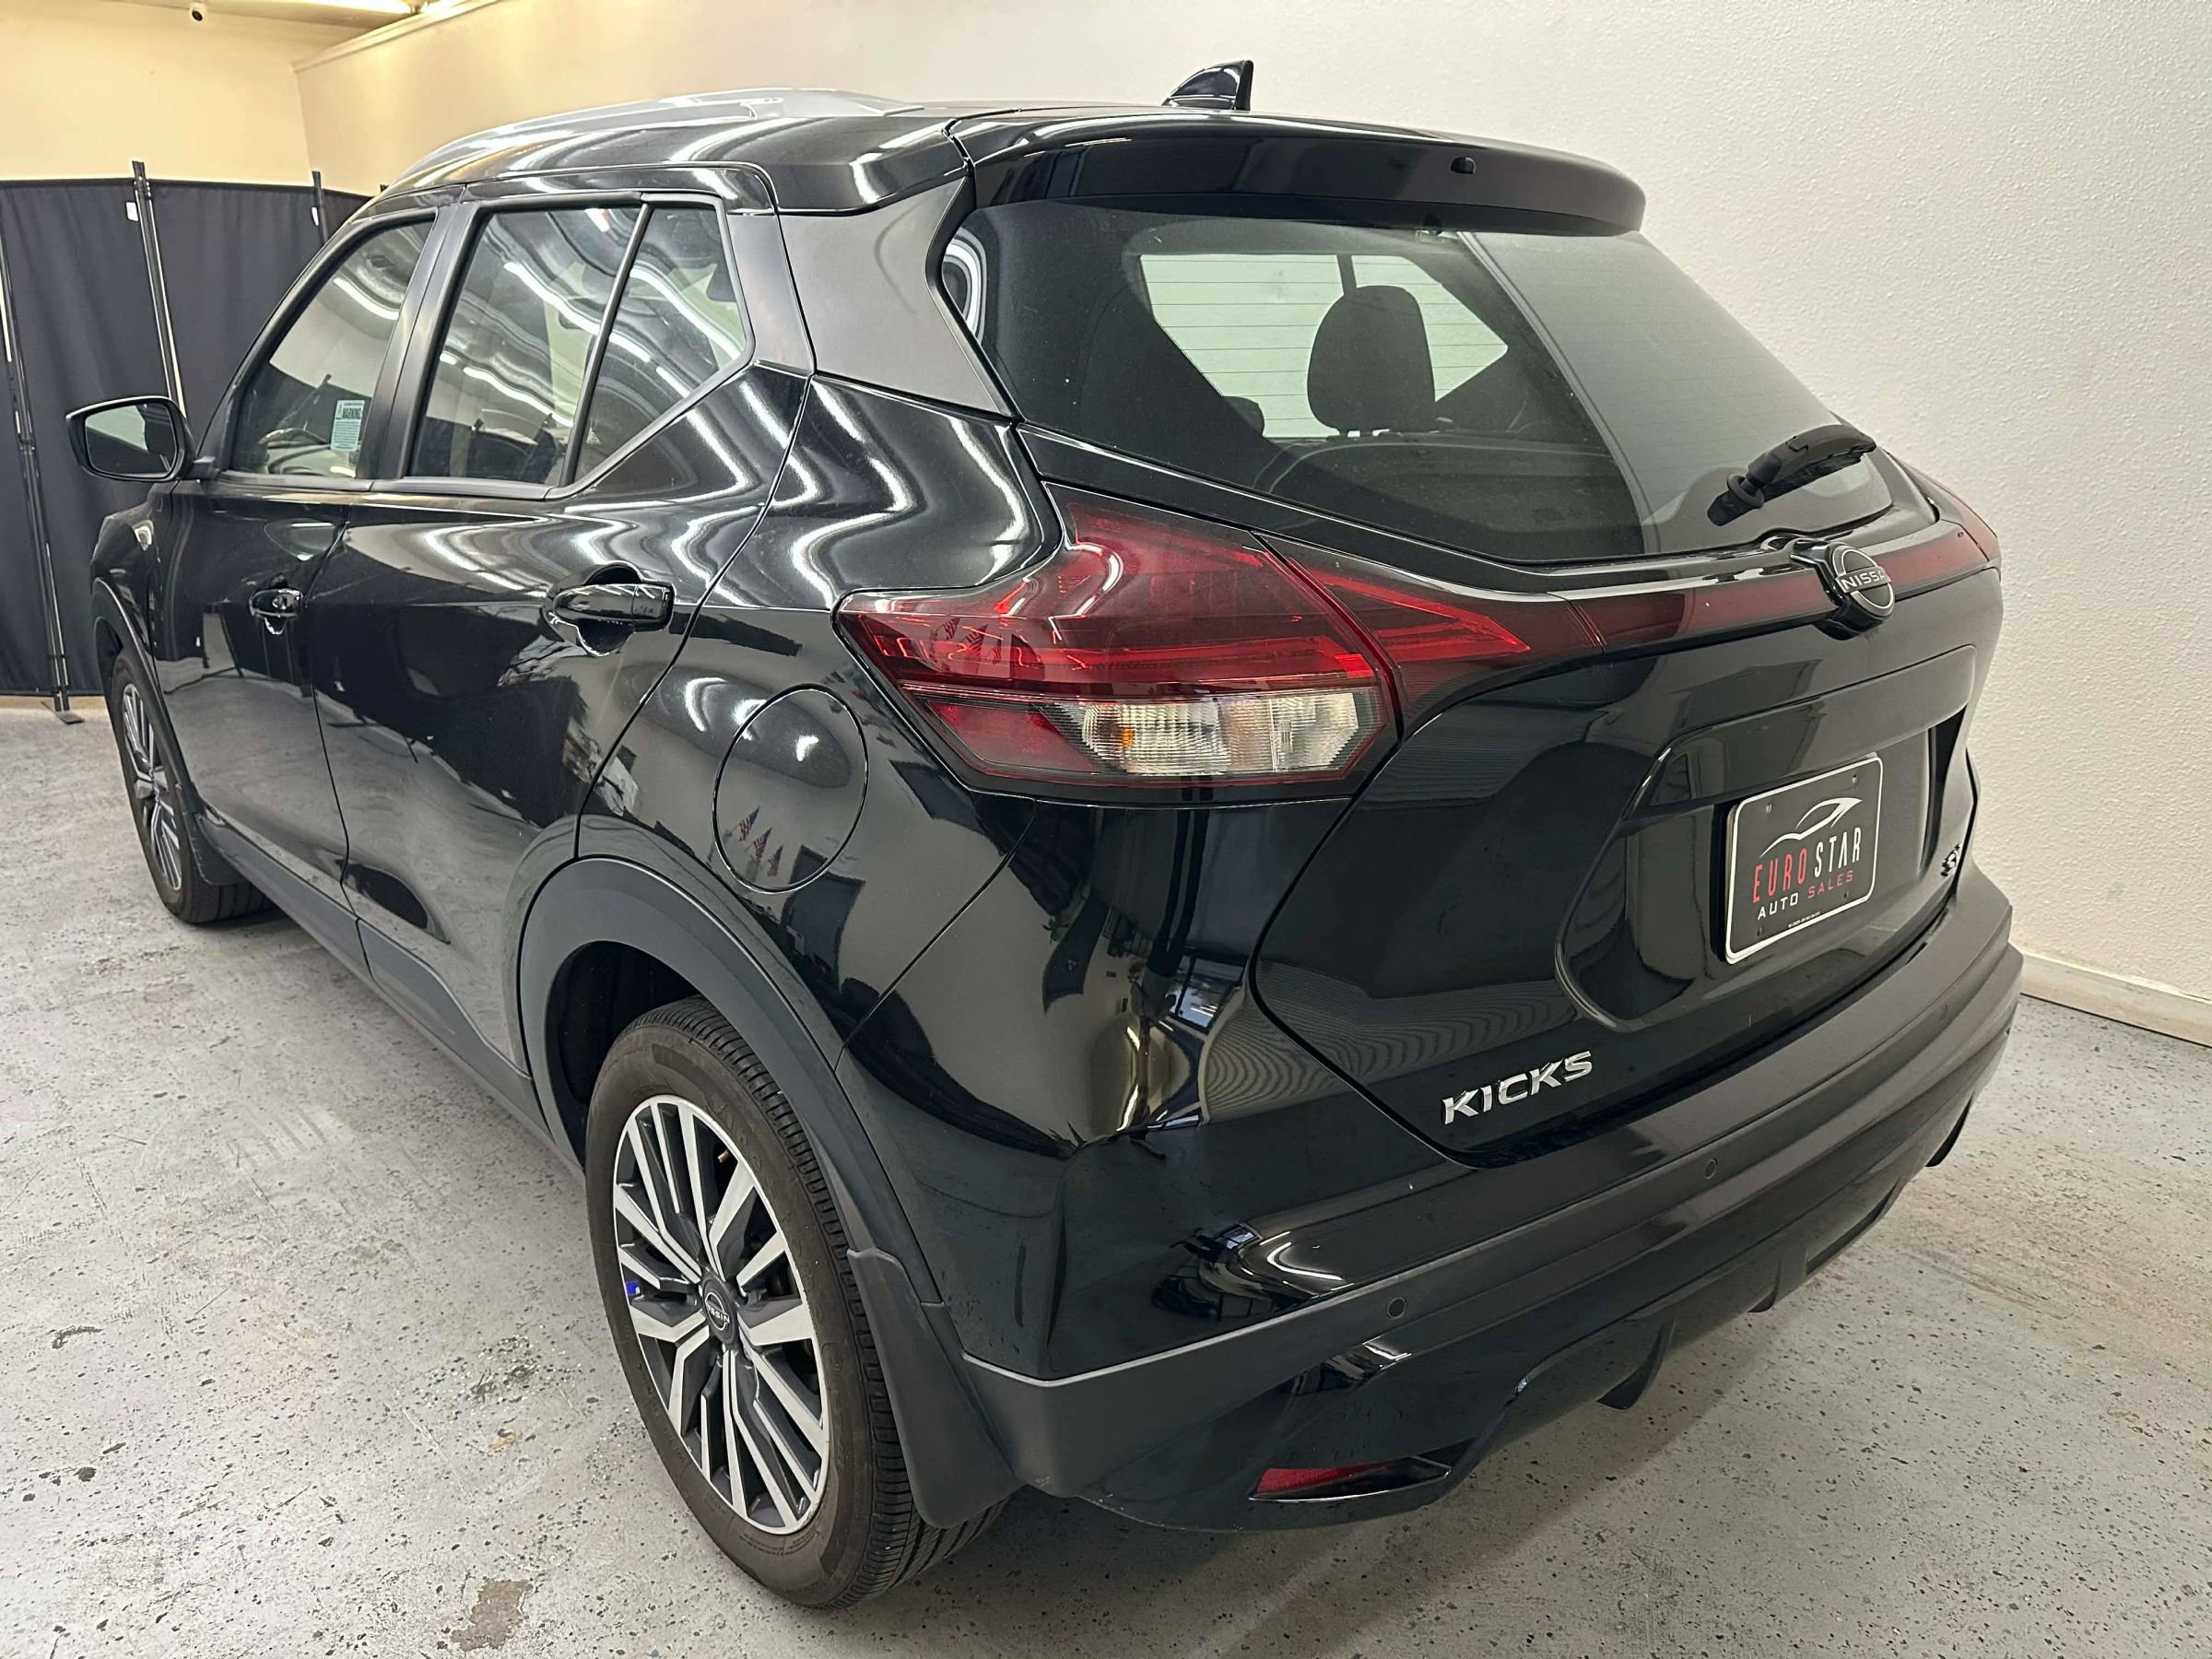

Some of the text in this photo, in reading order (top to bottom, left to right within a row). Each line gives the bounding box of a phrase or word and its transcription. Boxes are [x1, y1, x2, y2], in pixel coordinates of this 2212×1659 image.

[1841, 570, 1888, 590] NISSA
[1757, 892, 1798, 921] AUTO
[1806, 869, 1853, 900] SALES
[1441, 1050, 1593, 1125] KICKS
